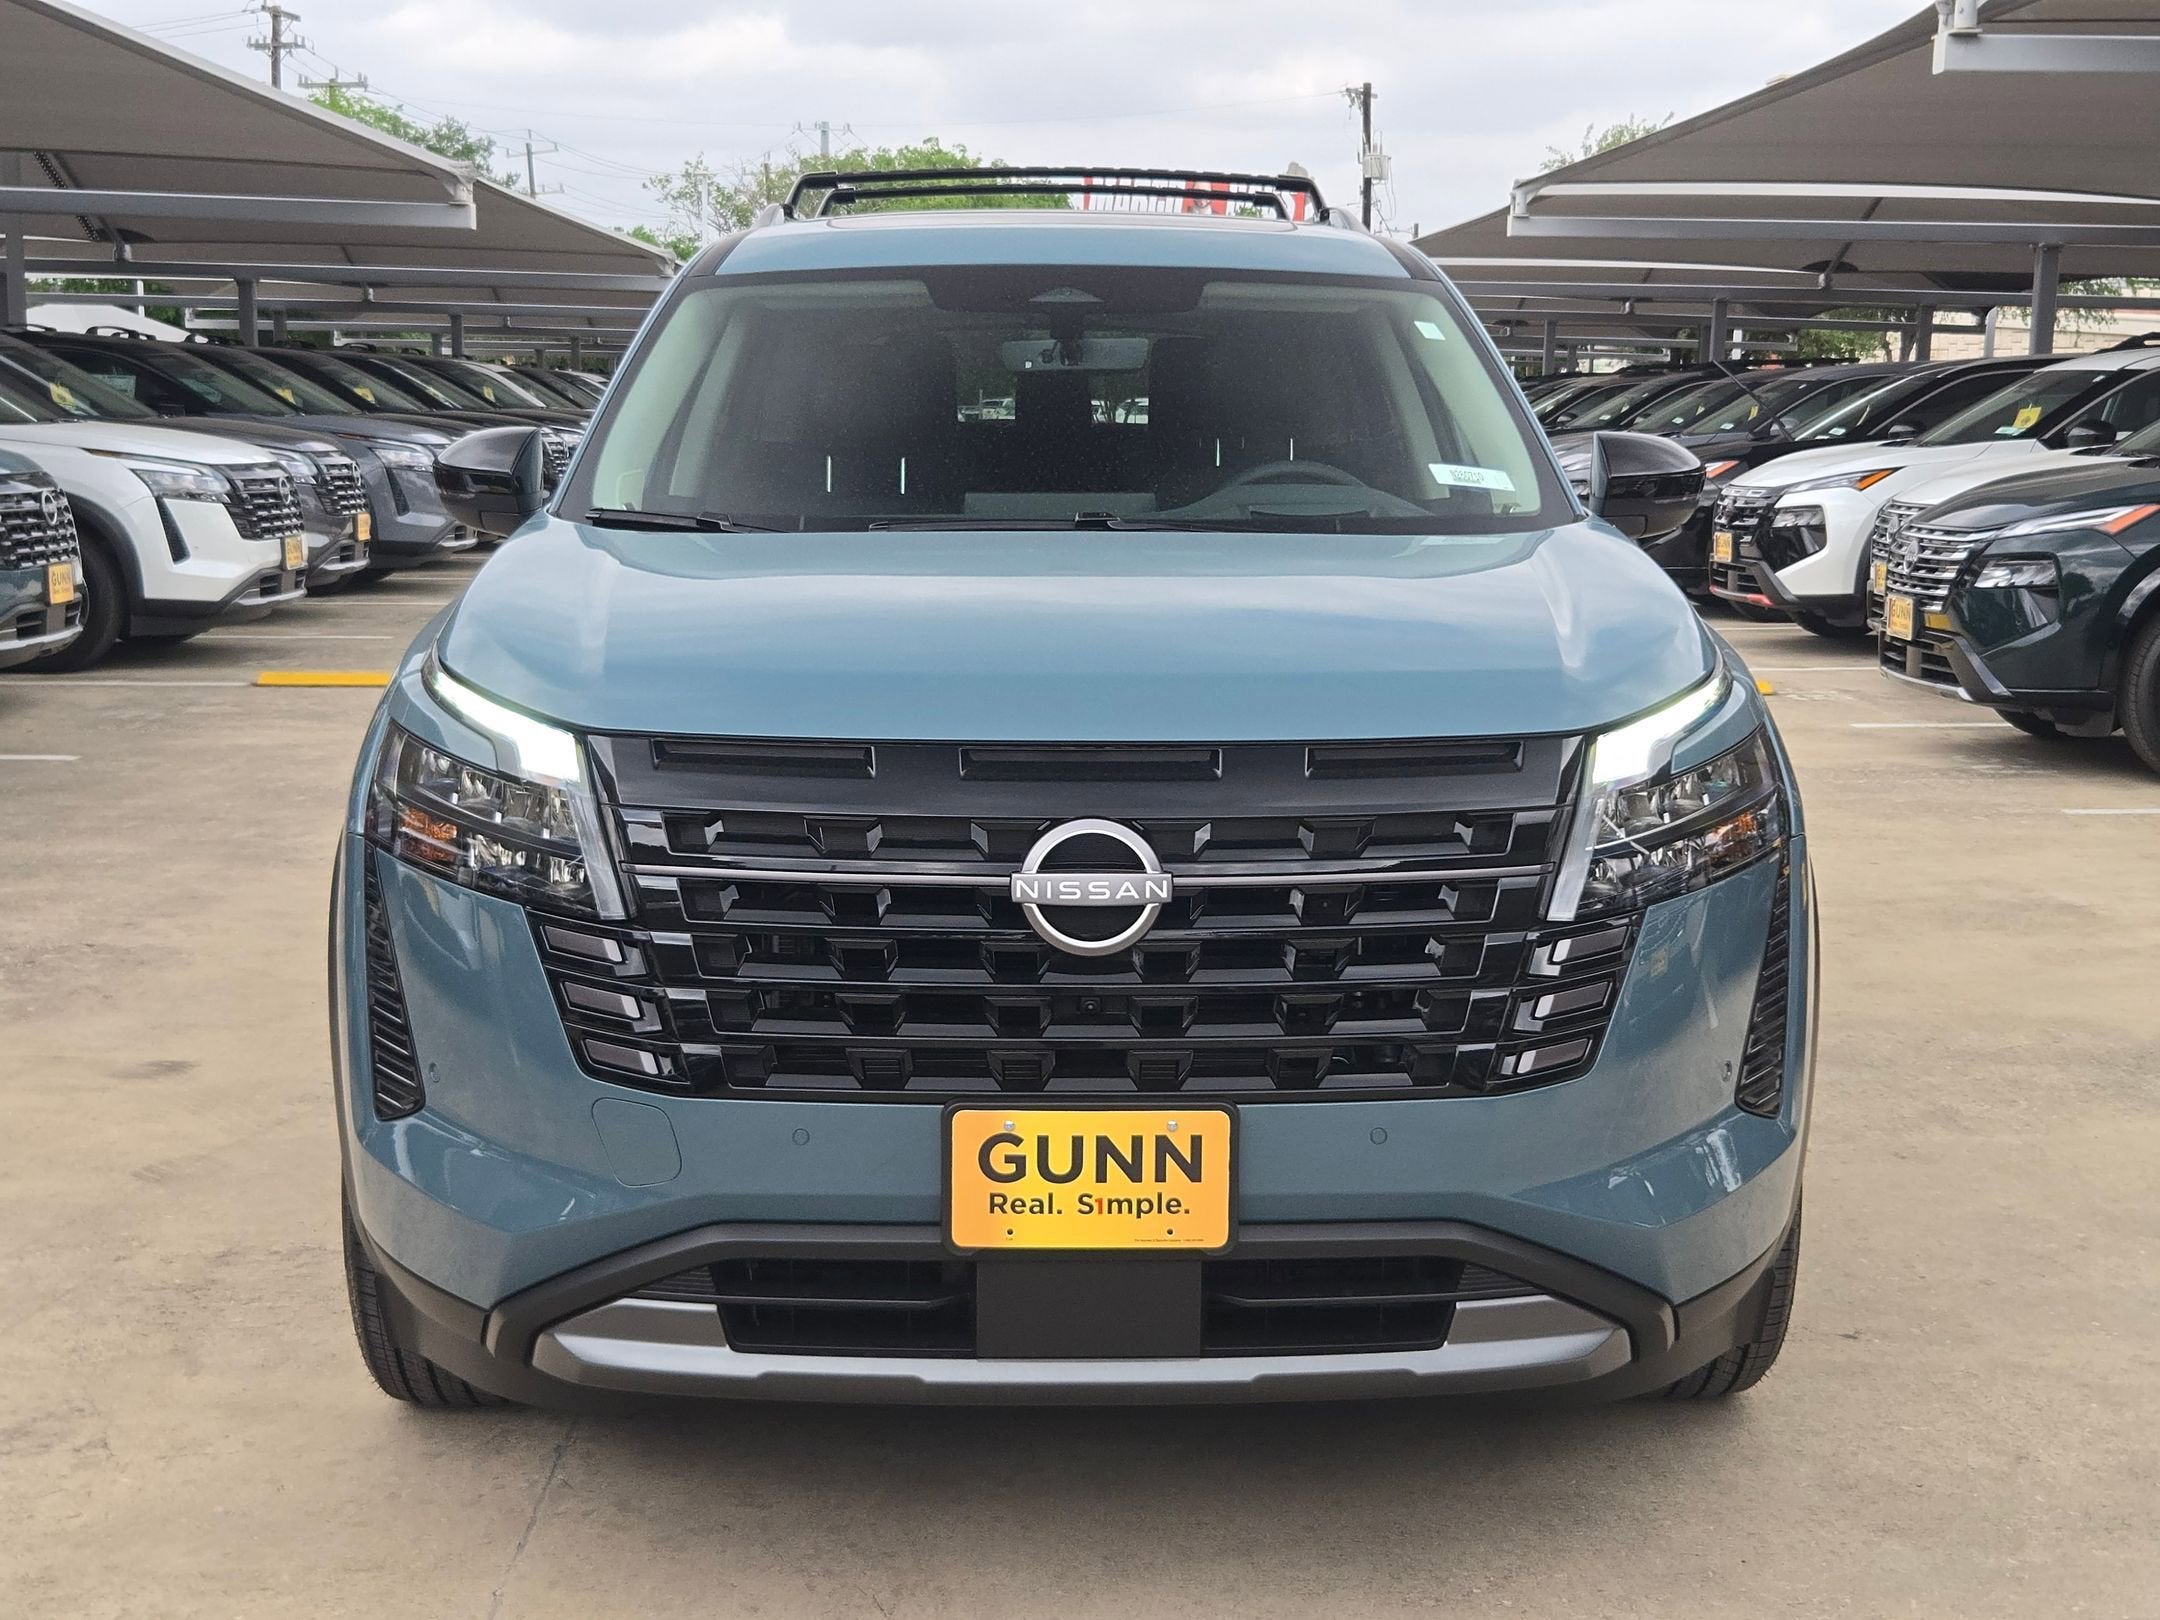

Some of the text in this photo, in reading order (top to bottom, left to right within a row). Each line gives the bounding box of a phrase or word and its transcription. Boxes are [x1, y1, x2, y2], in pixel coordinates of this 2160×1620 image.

[51, 569, 71, 586] GUNN
[1016, 880, 1168, 899] NISSAN
[978, 1132, 1203, 1184] GUNN
[989, 1192, 1063, 1215] Real.
